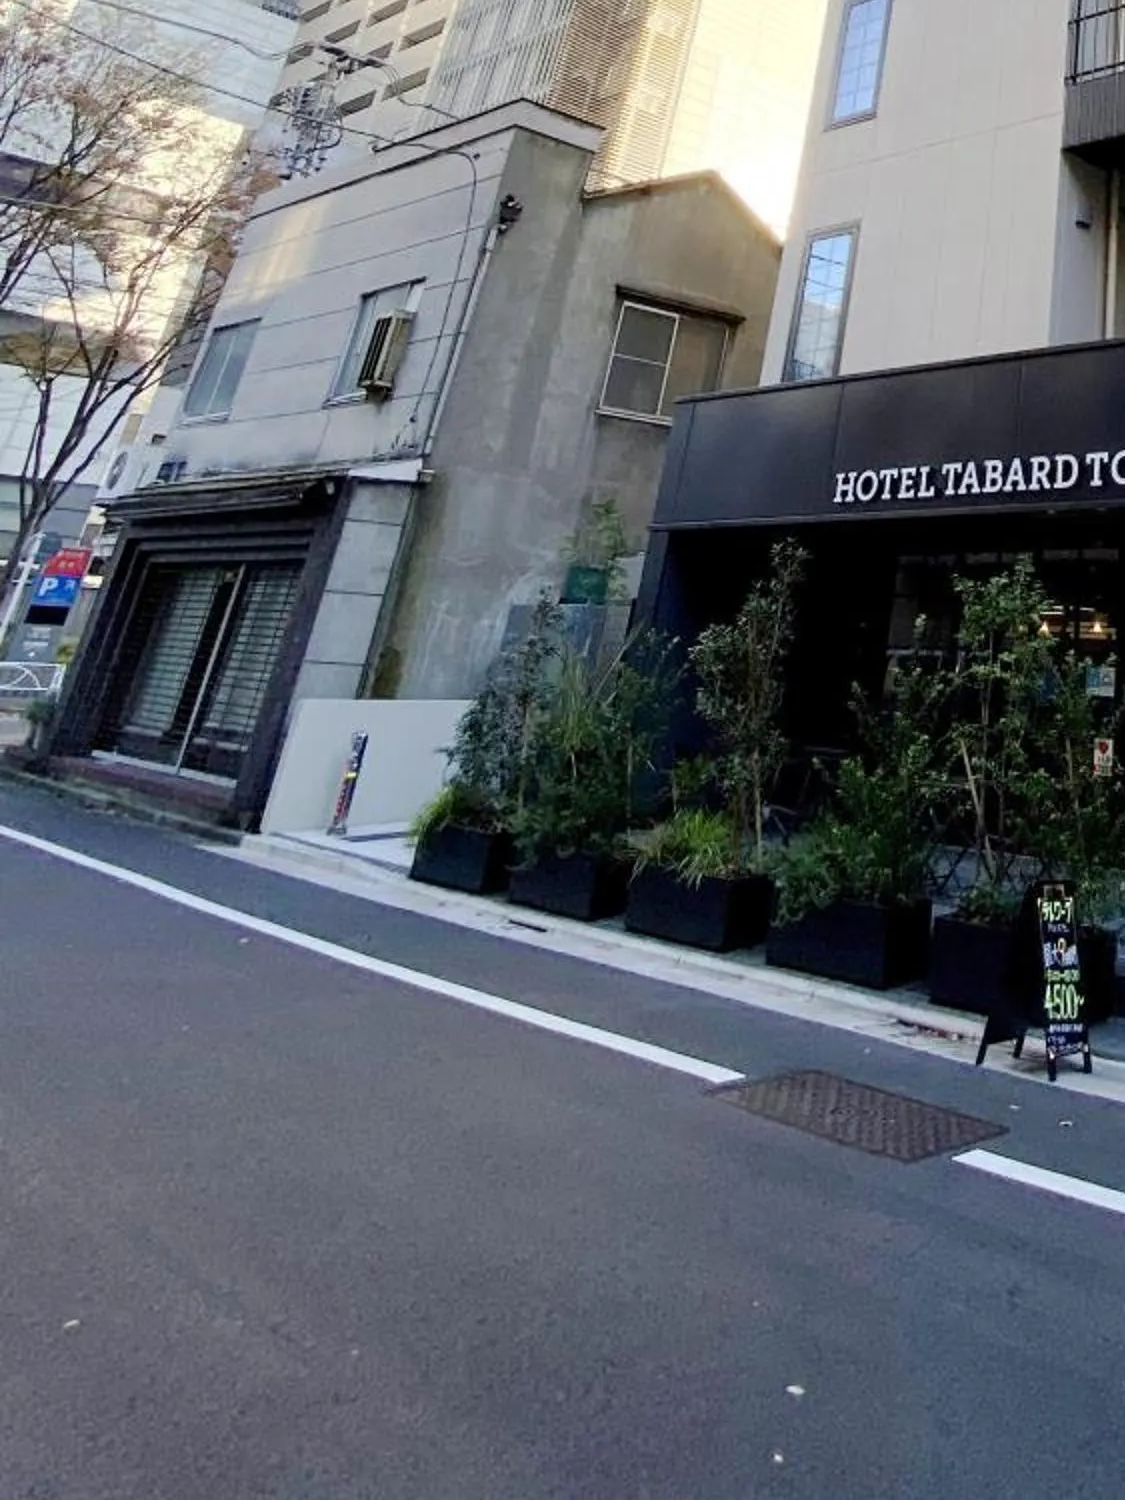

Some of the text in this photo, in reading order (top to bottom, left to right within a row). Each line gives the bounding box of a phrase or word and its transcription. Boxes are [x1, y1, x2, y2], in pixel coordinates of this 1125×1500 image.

[833, 465, 935, 503] HOTEL
[941, 454, 1079, 496] TABARD
[38, 577, 59, 597] P
